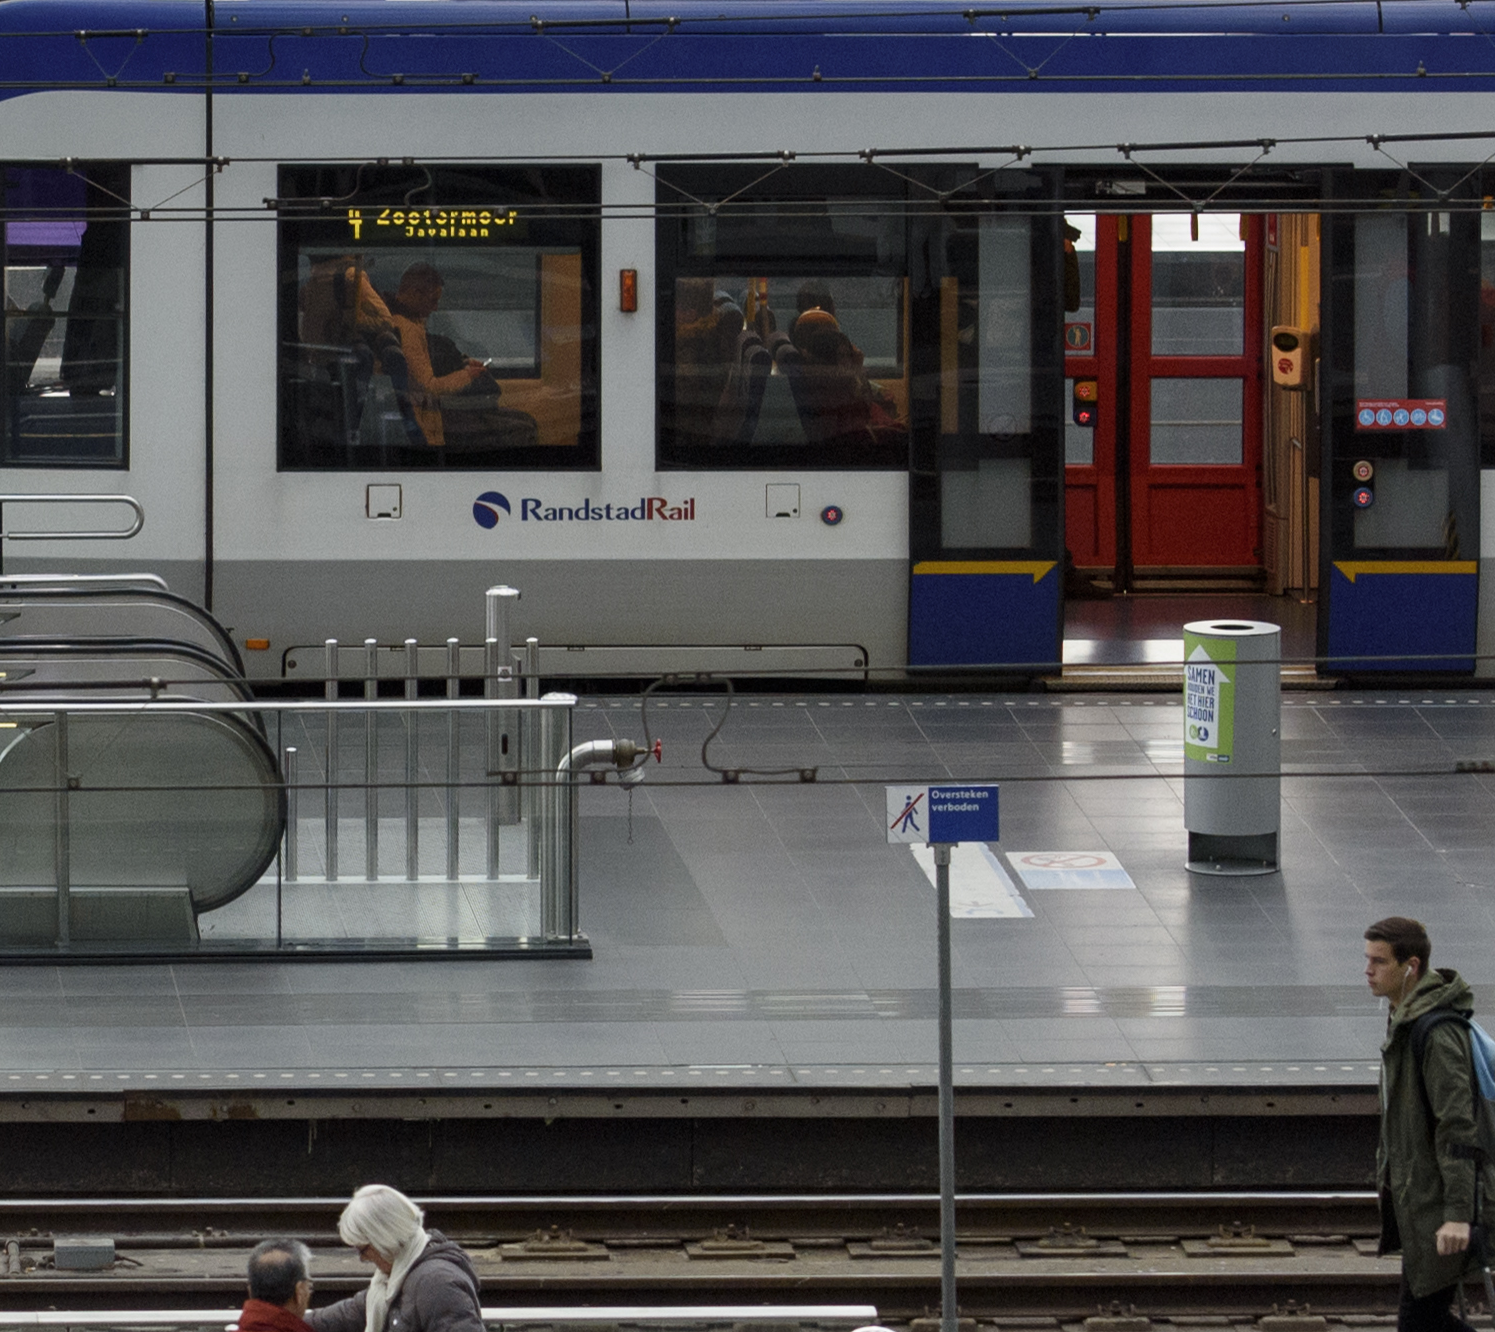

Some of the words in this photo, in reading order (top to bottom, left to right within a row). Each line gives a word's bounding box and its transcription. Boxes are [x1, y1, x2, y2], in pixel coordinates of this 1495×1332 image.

[404, 226, 490, 238] Javalaan
[520, 497, 696, 522] RandstadRail
[1187, 665, 1216, 685] SAMEN
[1206, 686, 1215, 696] WE
[1198, 694, 1215, 710] HIER
[1187, 705, 1215, 724] SCHOON
[931, 790, 989, 799] Oversteken
[931, 803, 980, 812] verboden
